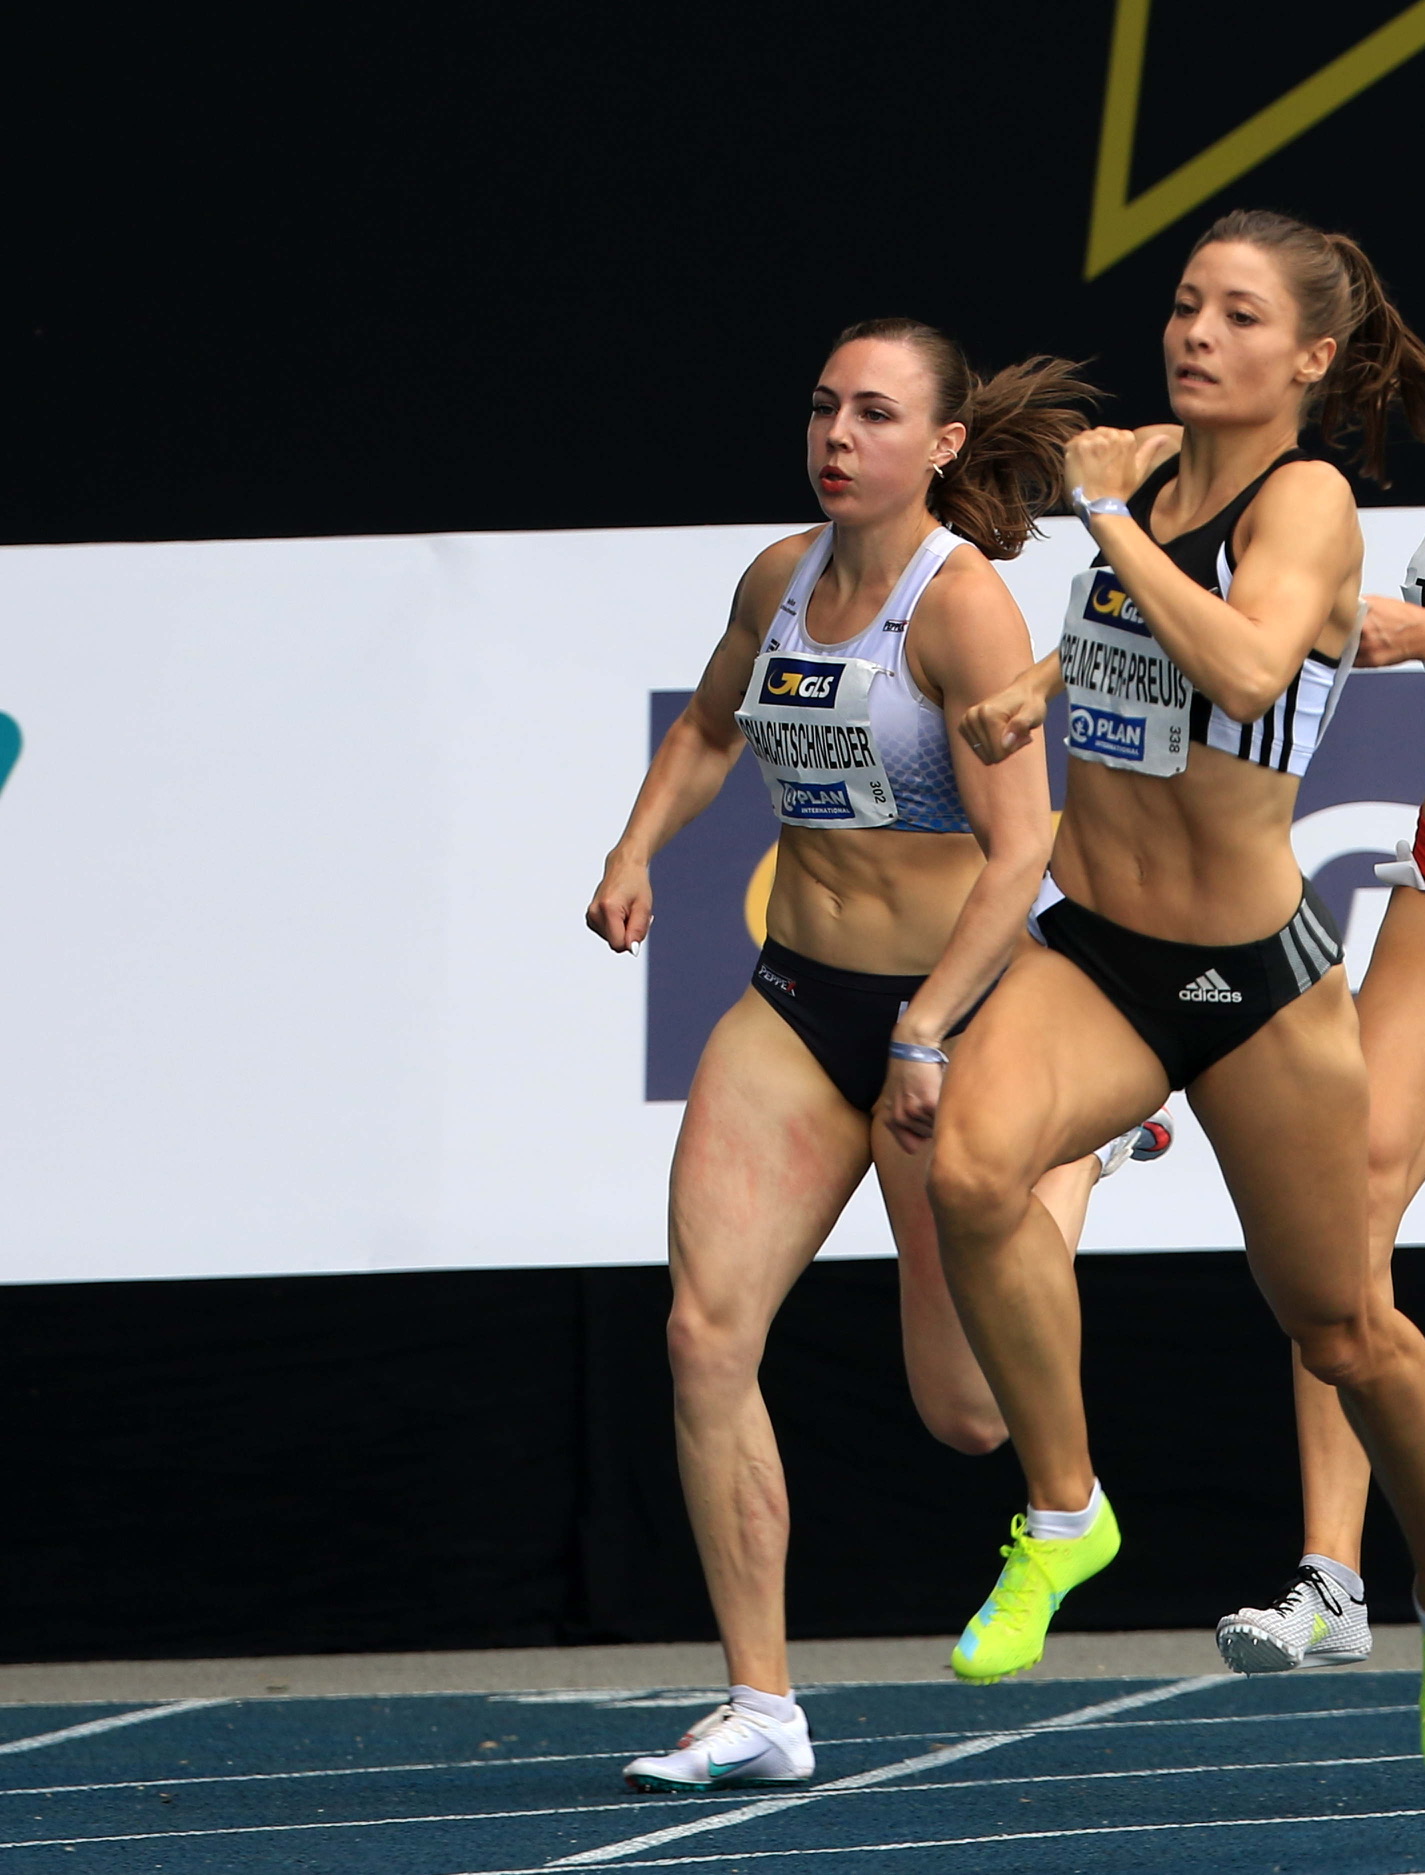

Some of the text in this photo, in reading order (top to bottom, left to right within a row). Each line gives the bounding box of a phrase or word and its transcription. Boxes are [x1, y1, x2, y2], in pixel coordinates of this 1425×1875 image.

[1121, 597, 1145, 624] GL
[799, 675, 834, 698] GLS
[1097, 718, 1141, 746] PLAN
[1168, 726, 1182, 753] 338
[797, 789, 846, 806] PLAN
[869, 780, 887, 804] 302
[1179, 988, 1242, 1003] adidas
